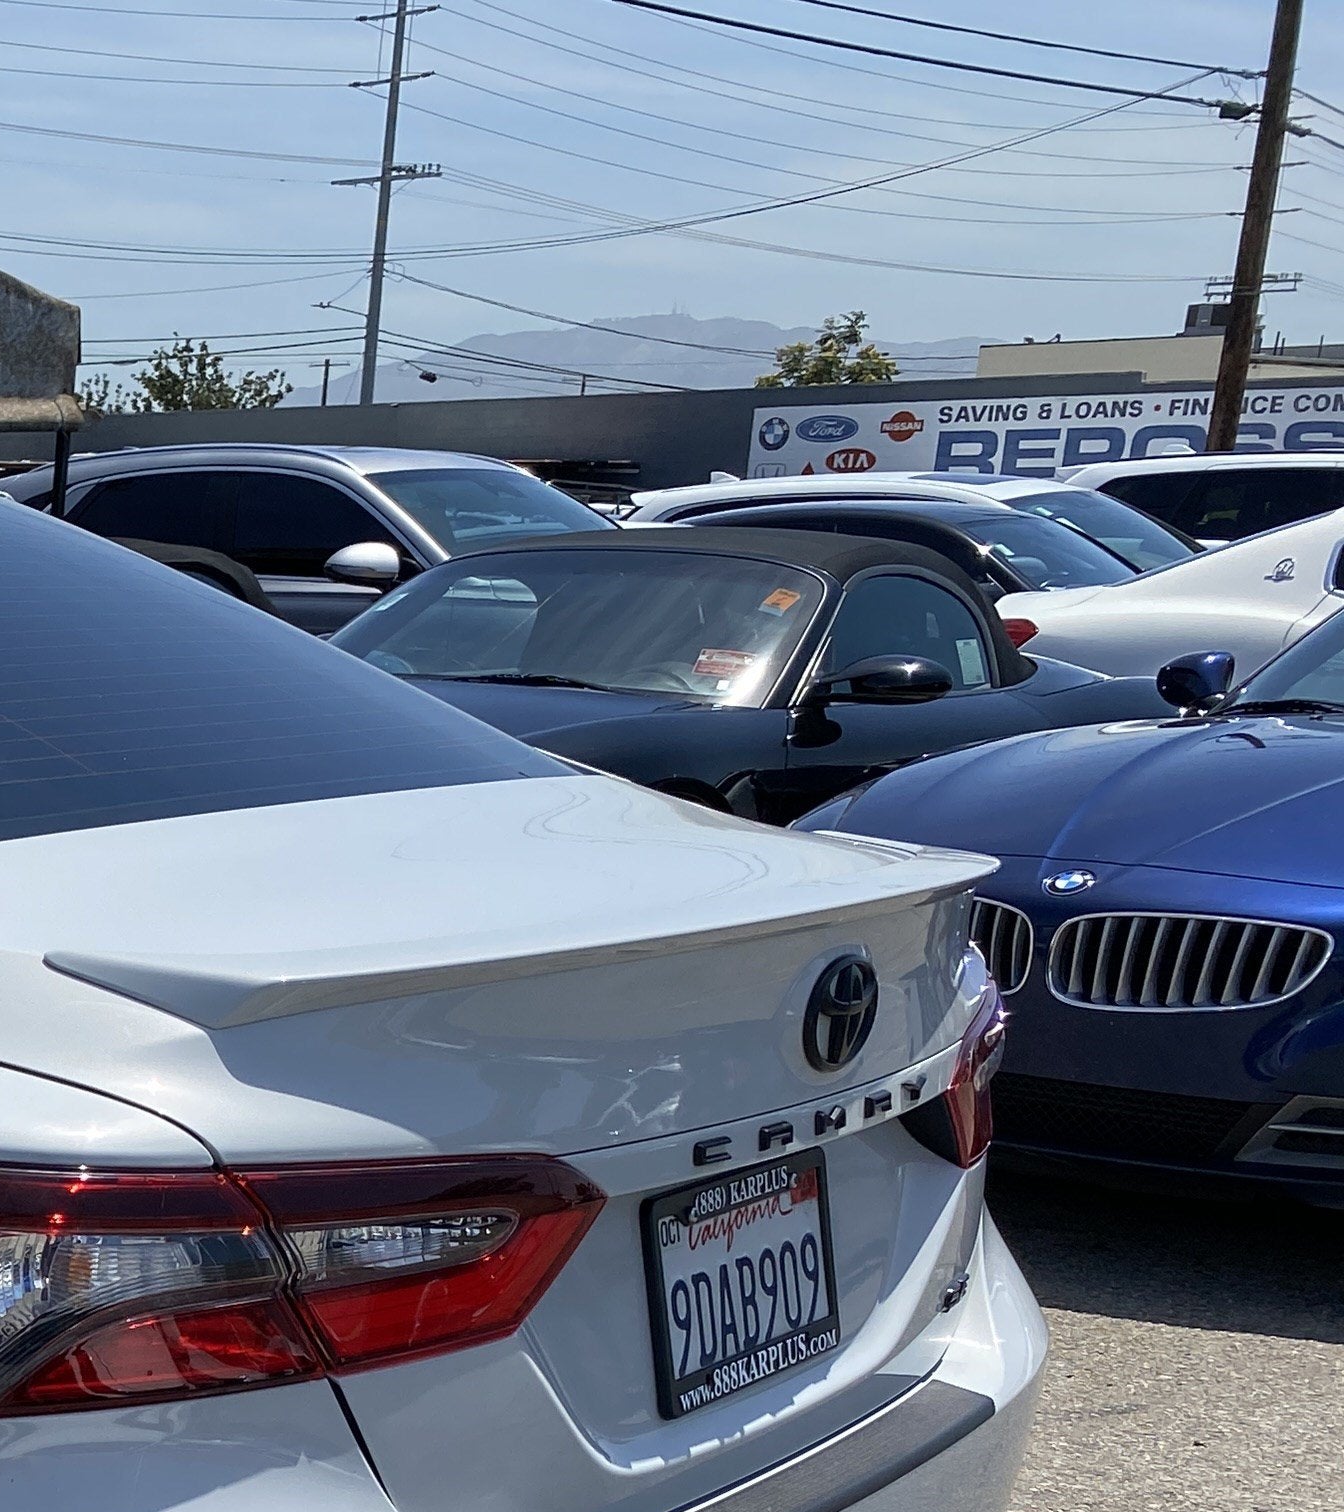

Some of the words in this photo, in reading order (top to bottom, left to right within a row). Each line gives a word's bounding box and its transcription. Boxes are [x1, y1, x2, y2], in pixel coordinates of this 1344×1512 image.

[938, 403, 1028, 424] SAVING
[1059, 400, 1144, 420] LOANS
[1168, 395, 1285, 417] FINCE
[808, 419, 846, 437] Ford
[882, 421, 922, 432] NISSAN
[832, 452, 871, 469] KIA
[694, 1189, 726, 1217] (888)
[729, 1165, 788, 1205] KARPLUS
[670, 1231, 820, 1379] 9DAB909
